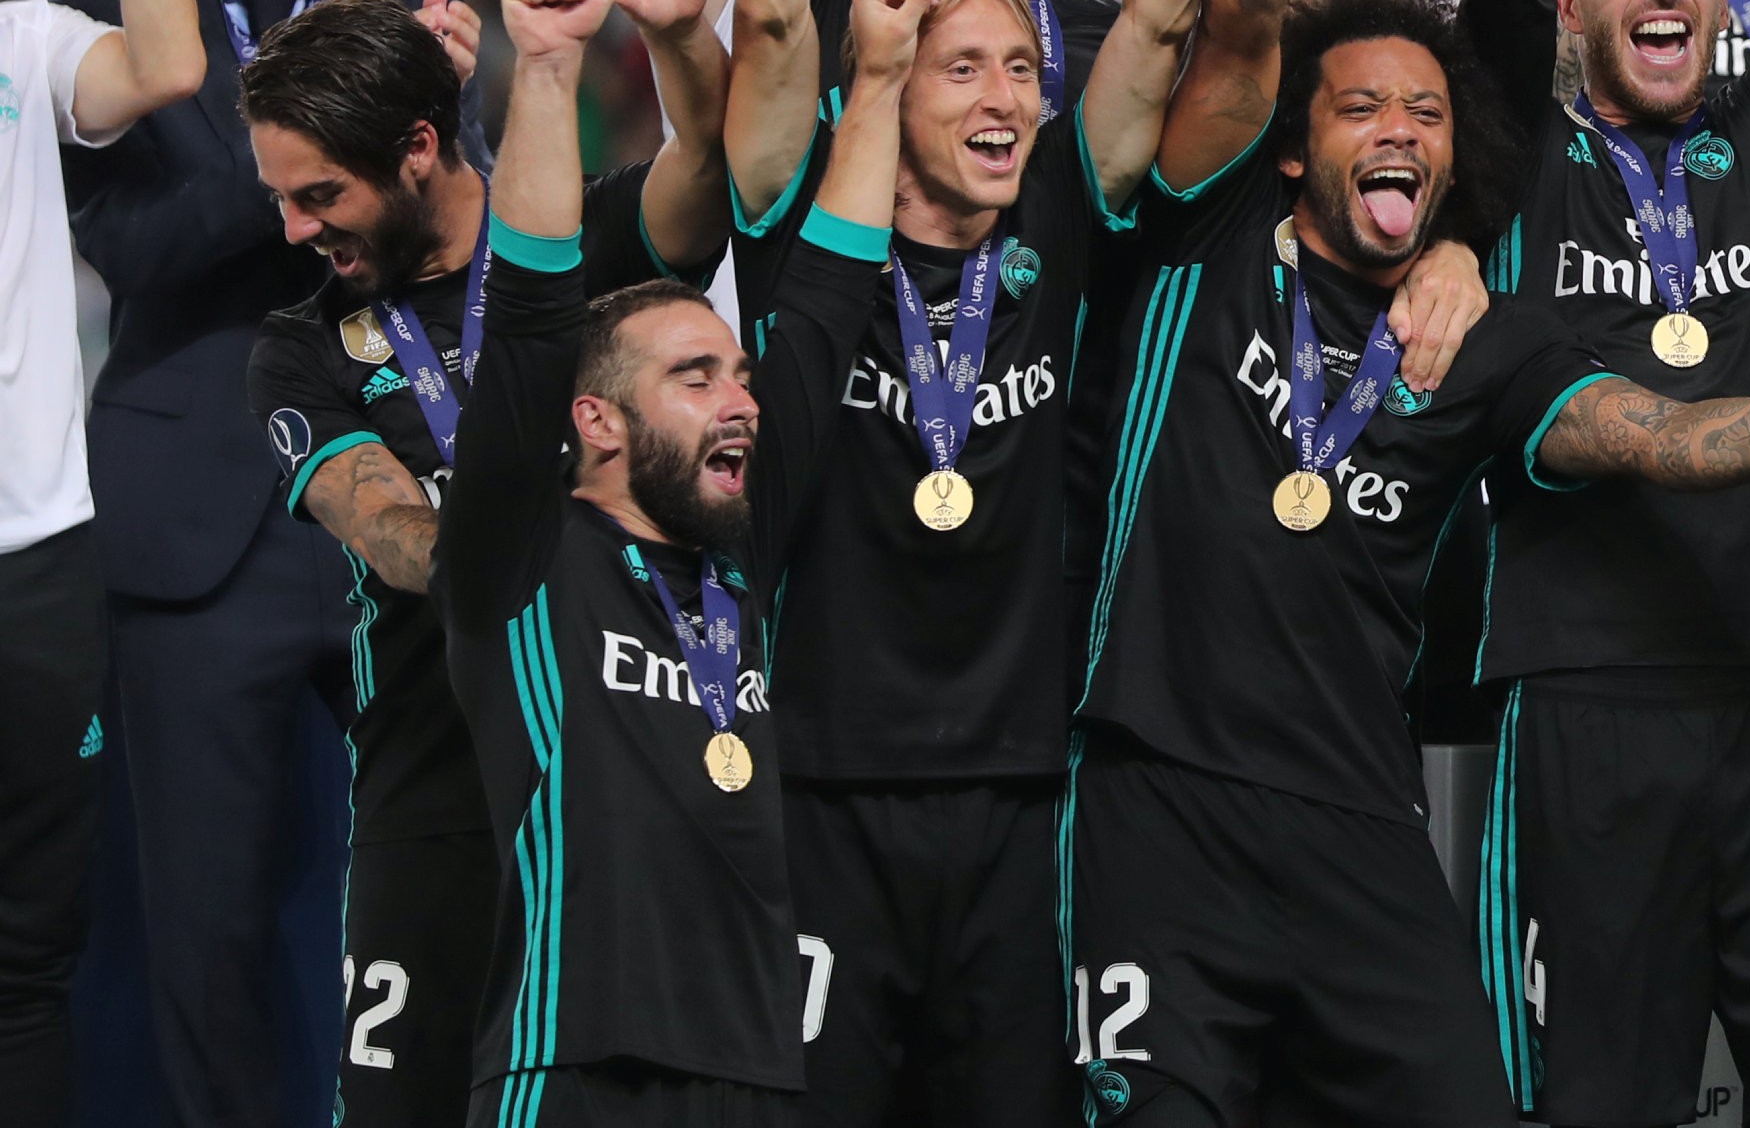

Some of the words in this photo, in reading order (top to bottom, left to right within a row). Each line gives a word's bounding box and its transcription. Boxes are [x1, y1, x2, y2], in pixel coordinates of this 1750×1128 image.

[1675, 204, 1687, 239] SKOPJE
[971, 273, 985, 302] UEFA
[1668, 278, 1683, 307] UEFA
[441, 348, 461, 360] UEF
[1320, 343, 1339, 356] UPER
[954, 353, 971, 393] SKOPJE
[841, 354, 1056, 426] Emates
[1351, 377, 1377, 415] SKOPJE
[1236, 328, 1410, 522] Emtes
[933, 434, 948, 464] UEFA
[1302, 432, 1313, 462] UEFA
[1319, 433, 1335, 460] CUP
[716, 617, 728, 655] SKOPJE
[713, 698, 728, 728] UEFA
[1523, 917, 1546, 1027] 4
[1074, 962, 1152, 1065] 12
[1696, 1086, 1732, 1118] UP
